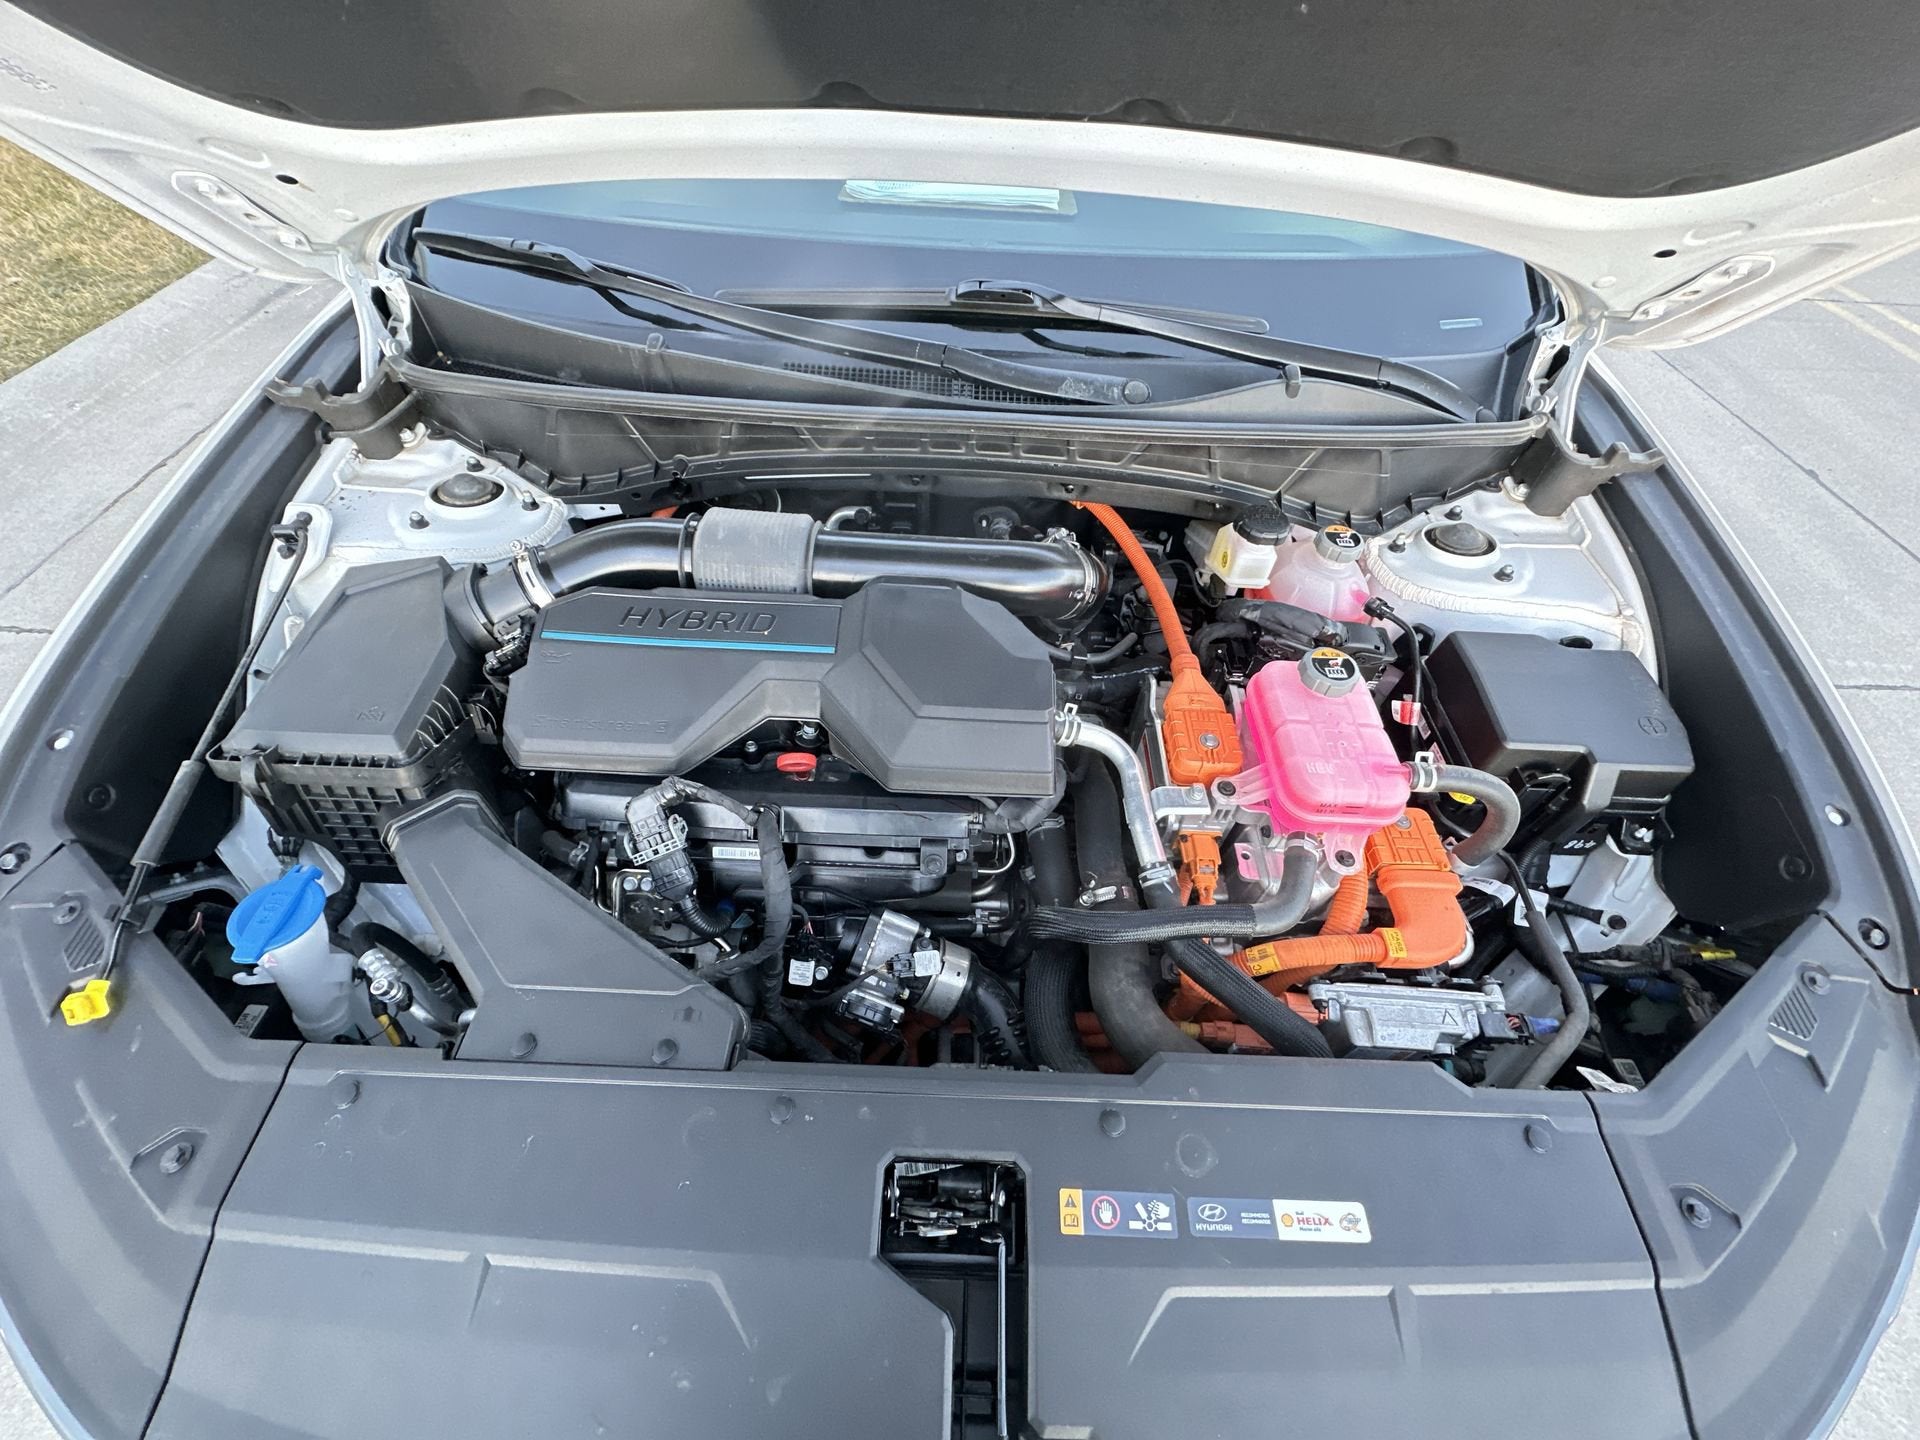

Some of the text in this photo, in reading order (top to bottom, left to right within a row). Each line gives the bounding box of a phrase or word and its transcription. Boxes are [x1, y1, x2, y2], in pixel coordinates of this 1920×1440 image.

[618, 606, 777, 634] HYBRID
[1296, 1215, 1334, 1226] HELIX
[1195, 1223, 1233, 1231] HYUNDAI
